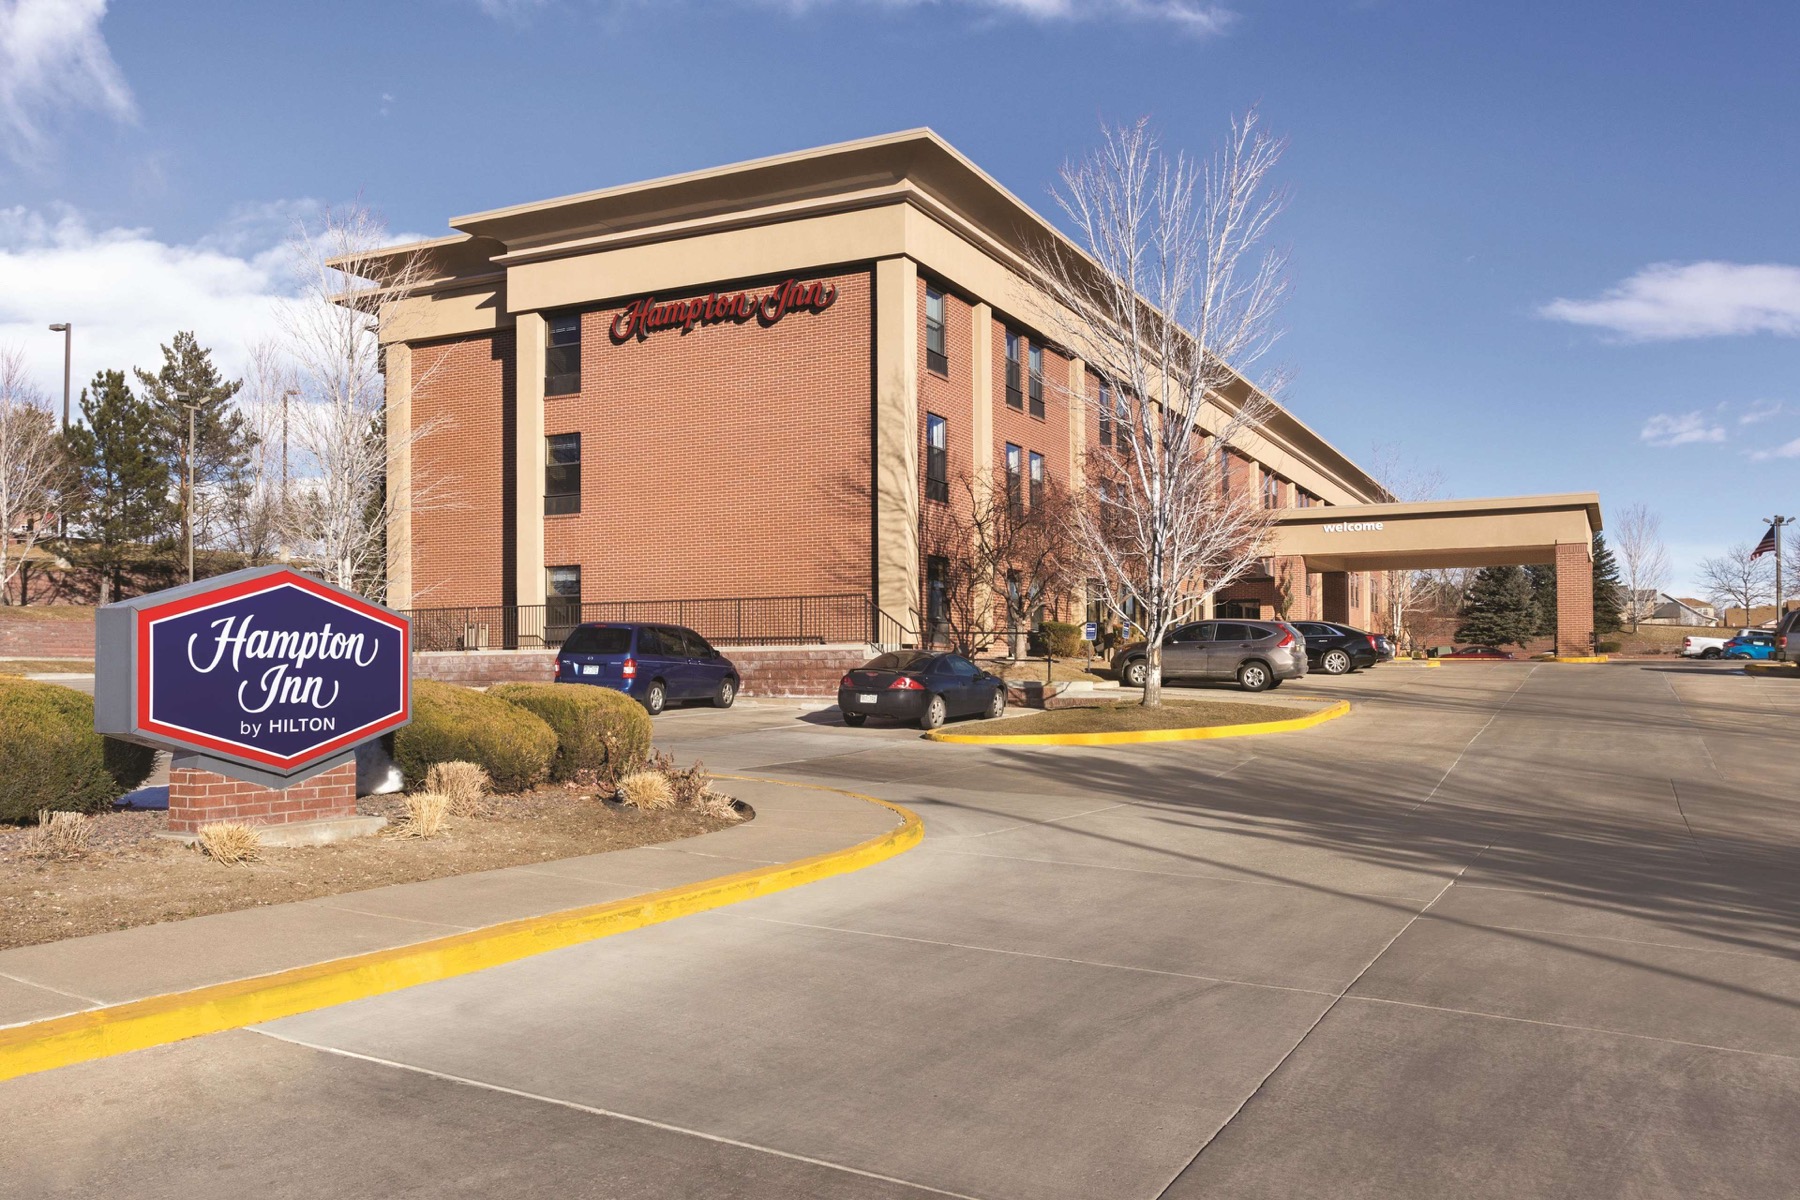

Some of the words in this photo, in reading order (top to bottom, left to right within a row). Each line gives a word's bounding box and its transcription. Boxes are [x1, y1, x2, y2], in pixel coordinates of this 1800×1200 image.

[612, 293, 758, 339] Hampton
[761, 278, 837, 321] Inn
[1323, 522, 1384, 532] welcome
[187, 614, 379, 673] Hampton
[237, 665, 339, 713] Inn
[240, 721, 262, 737] by
[269, 718, 336, 734] HILTON
